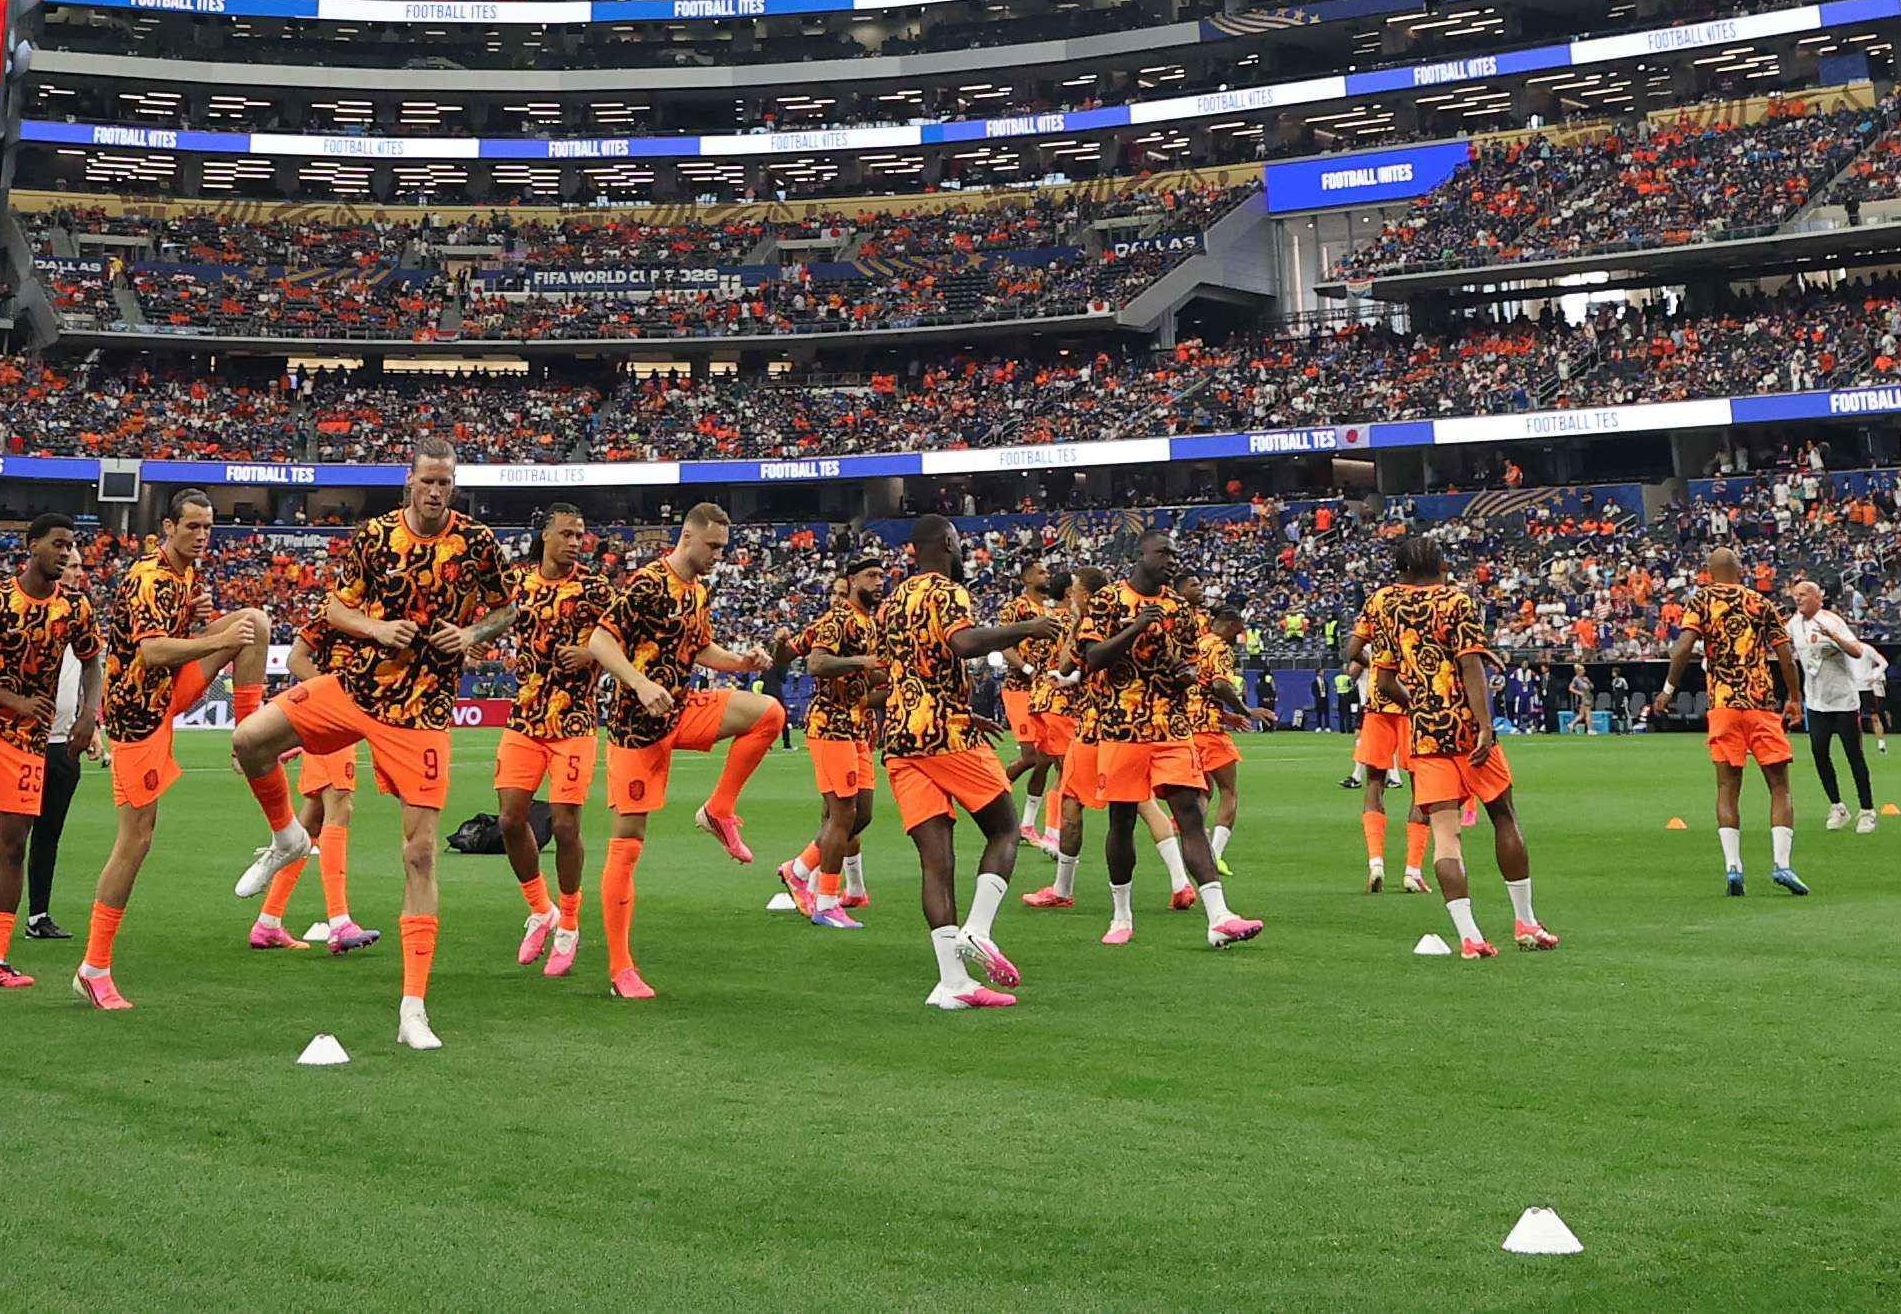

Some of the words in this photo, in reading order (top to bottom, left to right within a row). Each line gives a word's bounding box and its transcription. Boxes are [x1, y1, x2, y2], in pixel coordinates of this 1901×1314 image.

[33, 259, 103, 273] DALLAS
[533, 271, 567, 285] FIFA
[569, 270, 627, 285] WORLD
[423, 748, 438, 780] 9
[567, 755, 580, 782] 5
